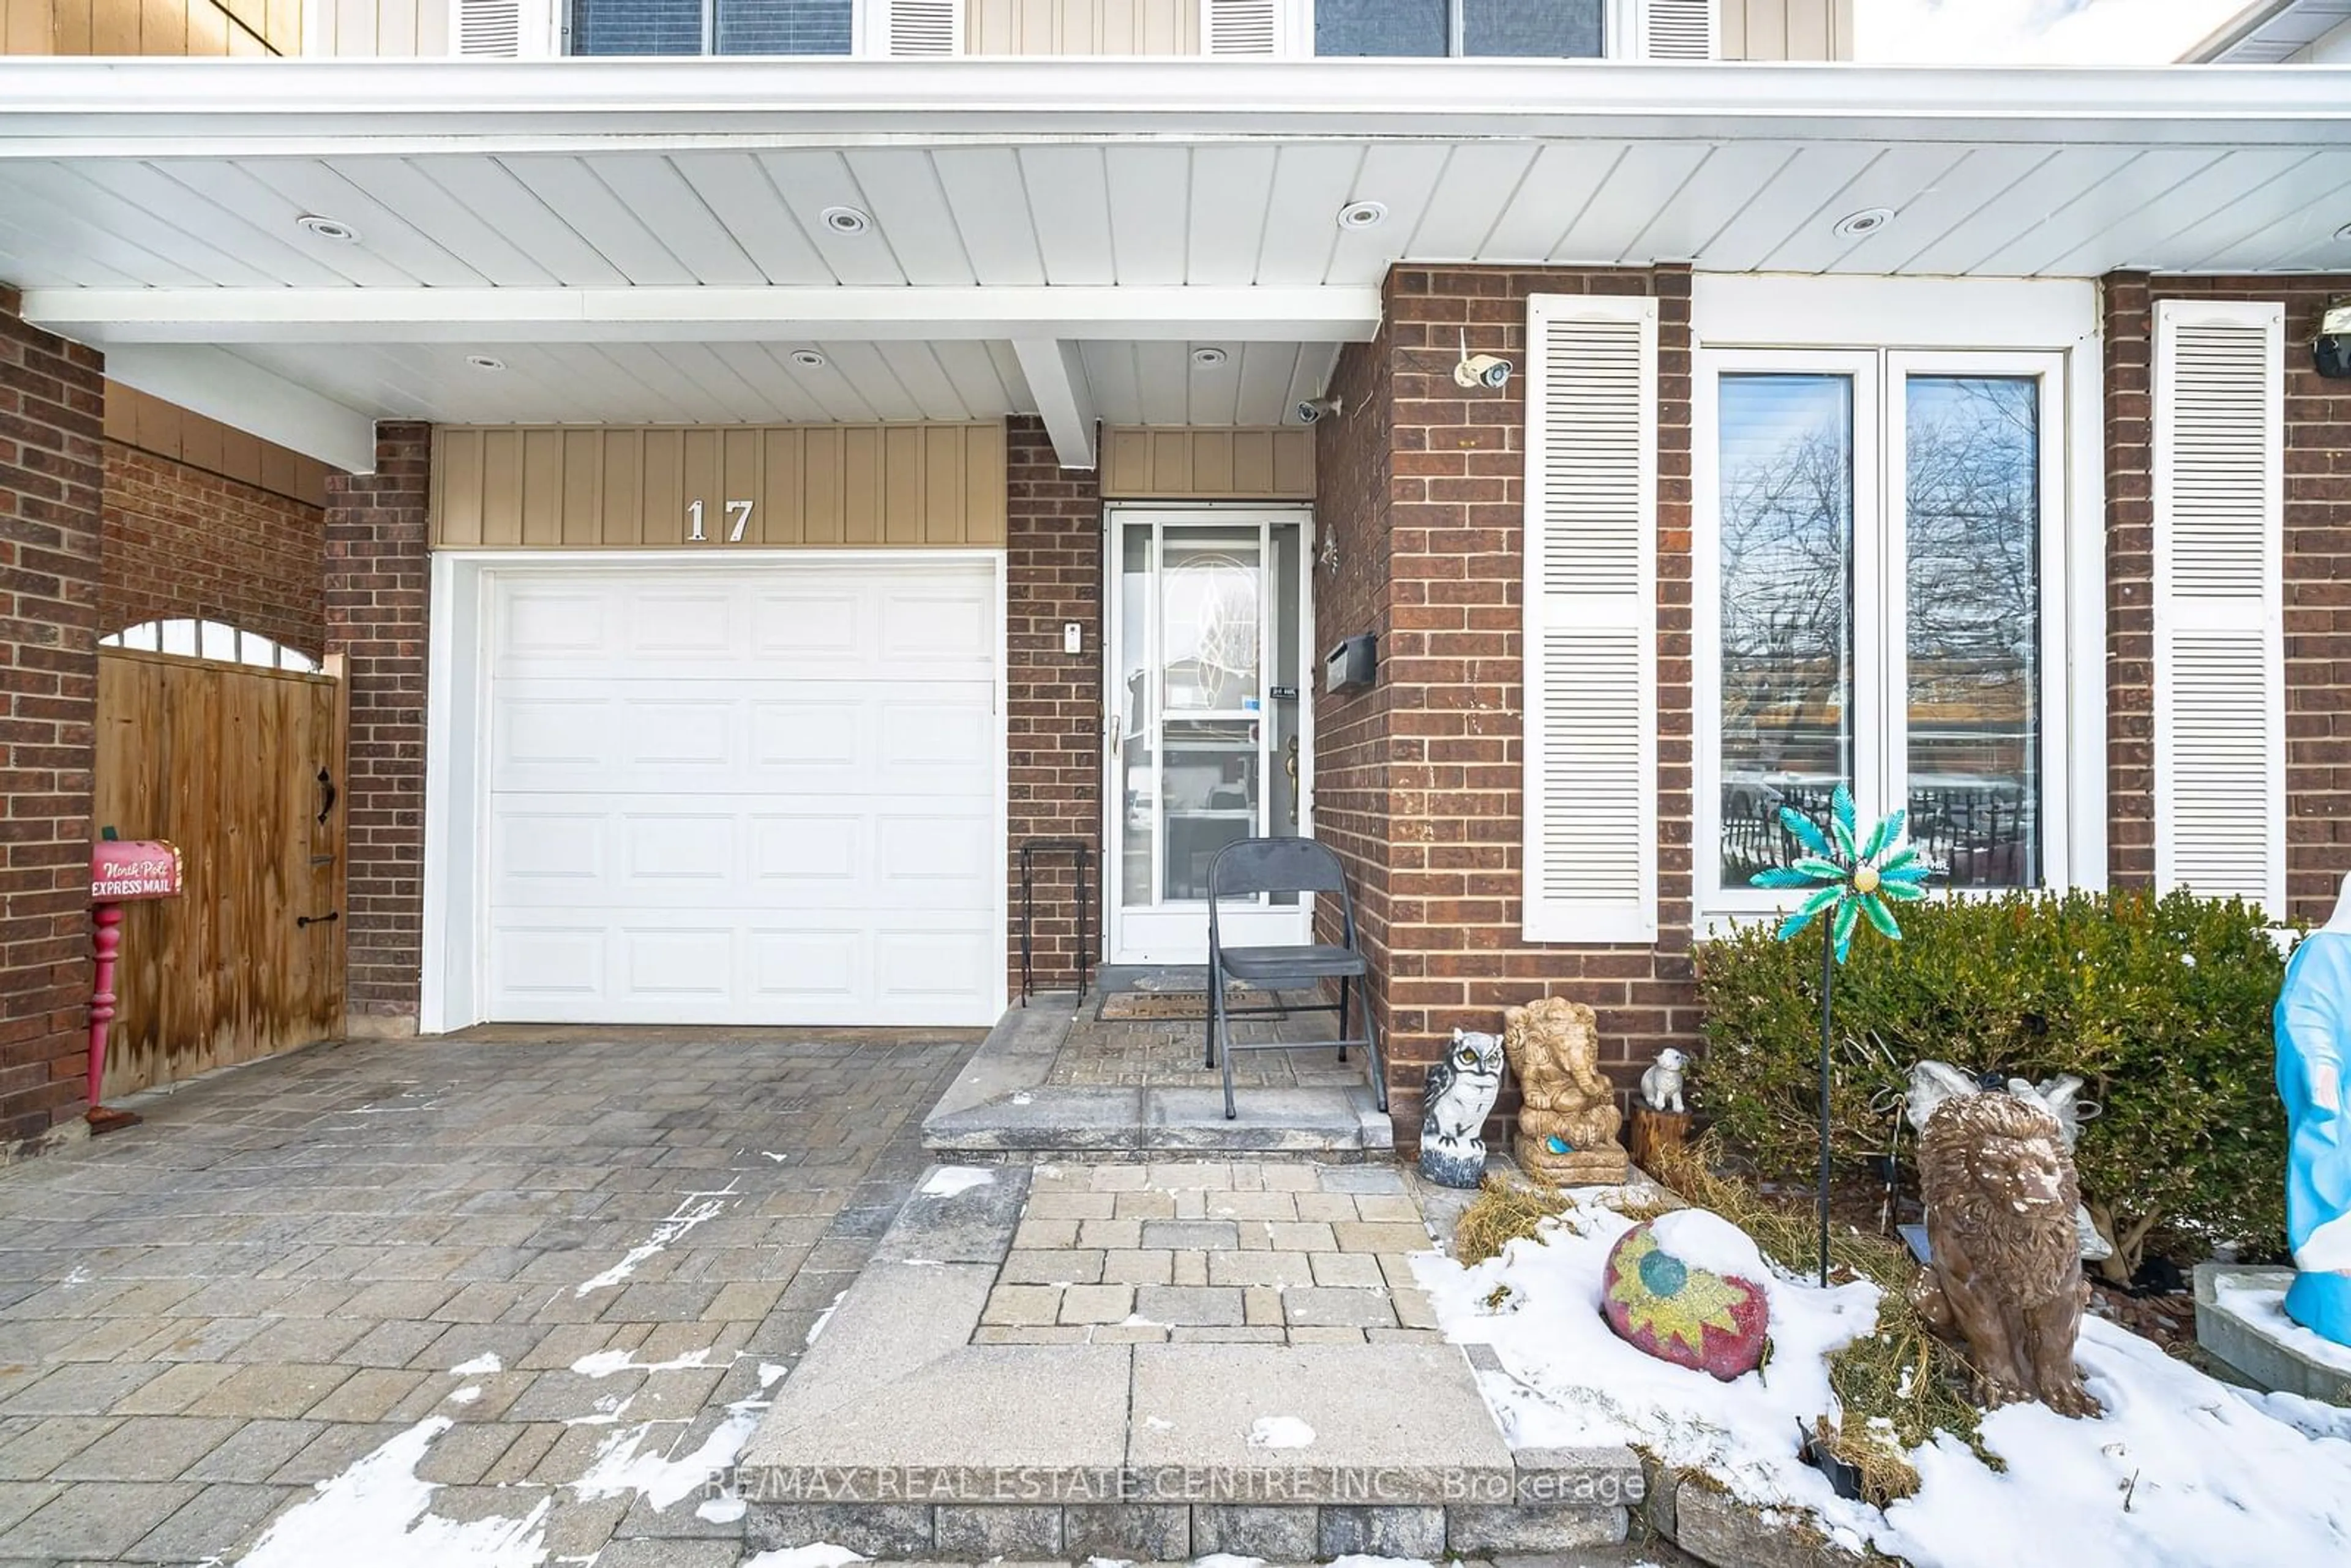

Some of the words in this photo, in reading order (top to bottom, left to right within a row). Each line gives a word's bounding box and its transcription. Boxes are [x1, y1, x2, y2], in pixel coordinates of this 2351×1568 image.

[688, 500, 754, 541] 17
[103, 861, 140, 878] North
[140, 861, 167, 876] Pole
[92, 880, 142, 896] EXPRESS
[143, 879, 170, 893] MAIL
